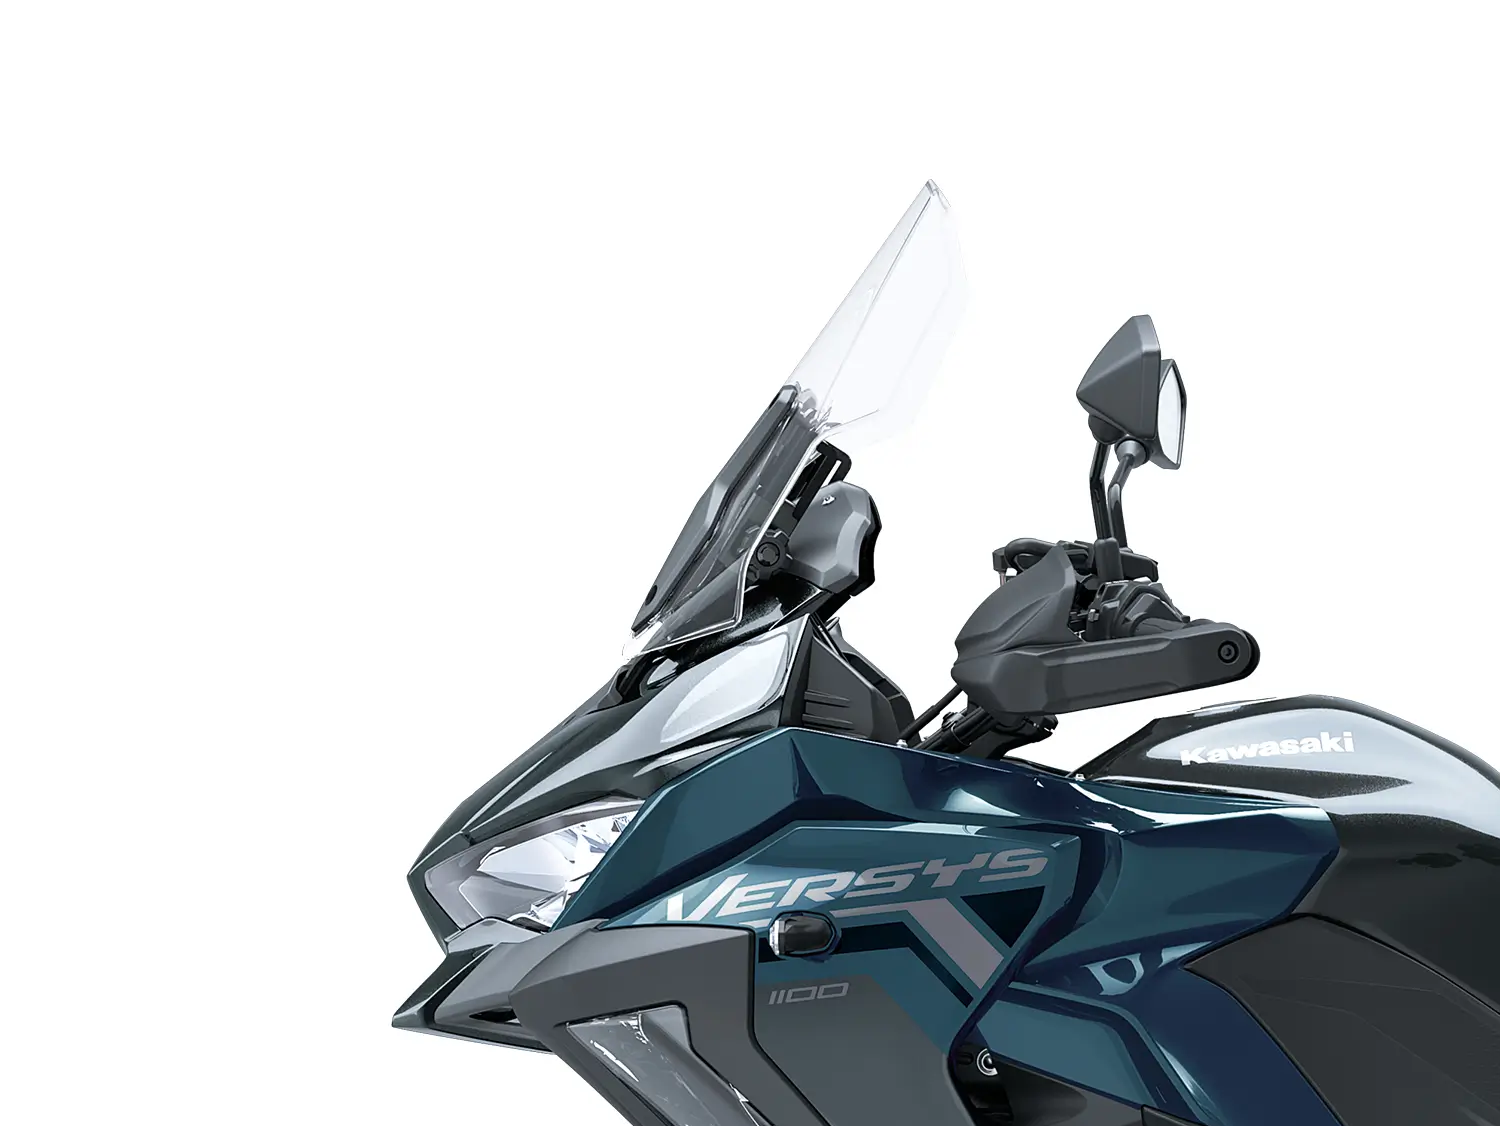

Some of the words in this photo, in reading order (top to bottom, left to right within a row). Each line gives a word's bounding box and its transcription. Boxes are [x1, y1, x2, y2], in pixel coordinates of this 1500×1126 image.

[1180, 731, 1354, 766] Kawasaki
[666, 848, 1048, 921] VERSYS
[768, 982, 850, 1005] 1100
